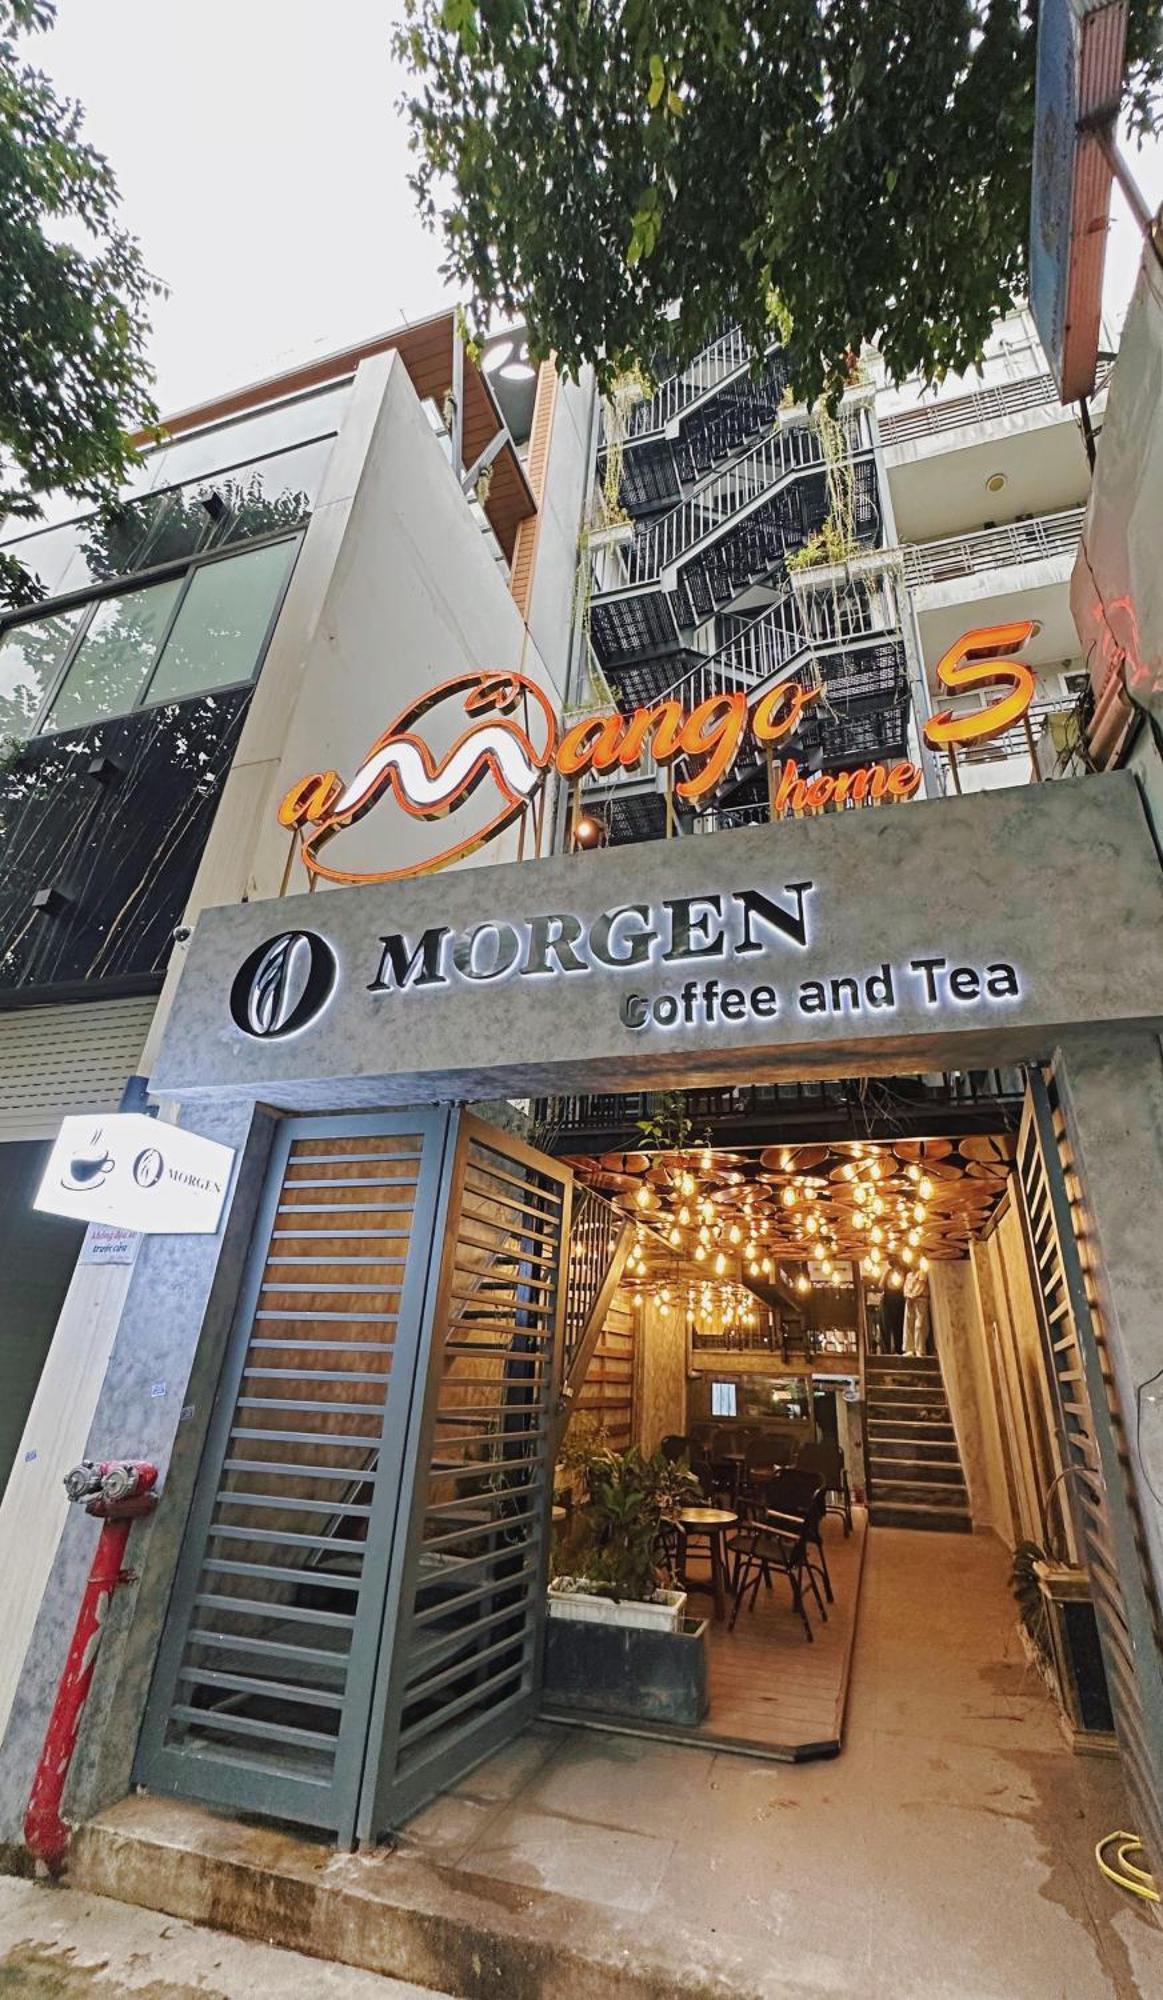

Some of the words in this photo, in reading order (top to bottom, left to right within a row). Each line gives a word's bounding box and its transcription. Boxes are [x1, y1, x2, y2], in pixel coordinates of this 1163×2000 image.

[923, 619, 1037, 748] 5
[775, 758, 923, 812] home
[366, 880, 814, 992] MORGEN
[799, 963, 895, 1015] and
[911, 957, 1020, 1004] Tea
[168, 1168, 222, 1193] MORGEN
